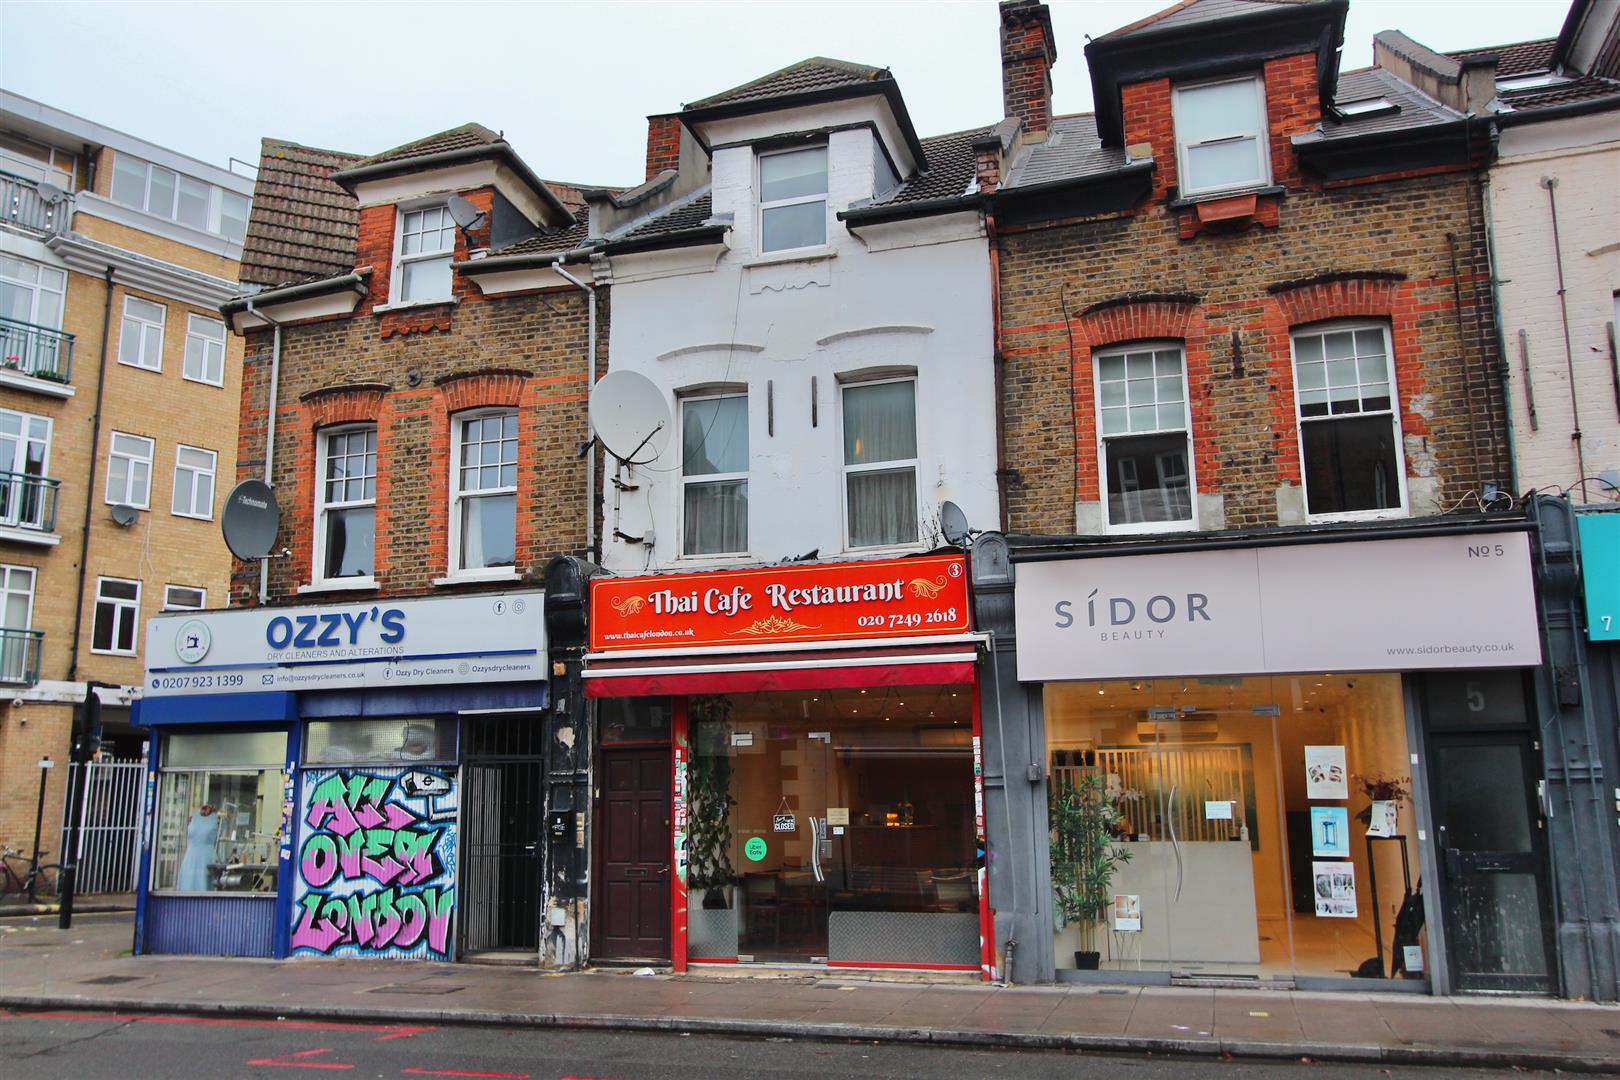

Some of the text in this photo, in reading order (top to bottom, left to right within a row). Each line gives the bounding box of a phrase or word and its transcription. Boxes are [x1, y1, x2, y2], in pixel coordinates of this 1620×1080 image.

[1494, 544, 1504, 557] 5
[952, 564, 959, 576] 3
[648, 578, 905, 617] Thai Cafe Restaurant
[857, 607, 957, 628] 020 7249 2618
[1600, 615, 1612, 632] 7
[266, 606, 406, 650] OZZY'S
[603, 627, 695, 641] www.thaicafelondon.co.uk
[1100, 629, 1166, 642] BEAUTY
[267, 646, 405, 661] DRY CLEANERS AND ALTERATIONS
[1386, 642, 1515, 656] www.sidorbeauty.co.uk
[395, 667, 454, 678] Ozzy Dry Cleaners
[472, 663, 531, 673] Ozzysdrycleaners
[162, 675, 244, 689] 0207 923 1399
[276, 671, 366, 683] info@ozzysdrycleaners.co.uk
[1465, 680, 1486, 712] 5
[774, 822, 794, 831] CLOSED
[301, 828, 439, 888] OVER
[292, 887, 455, 955] LONDON
